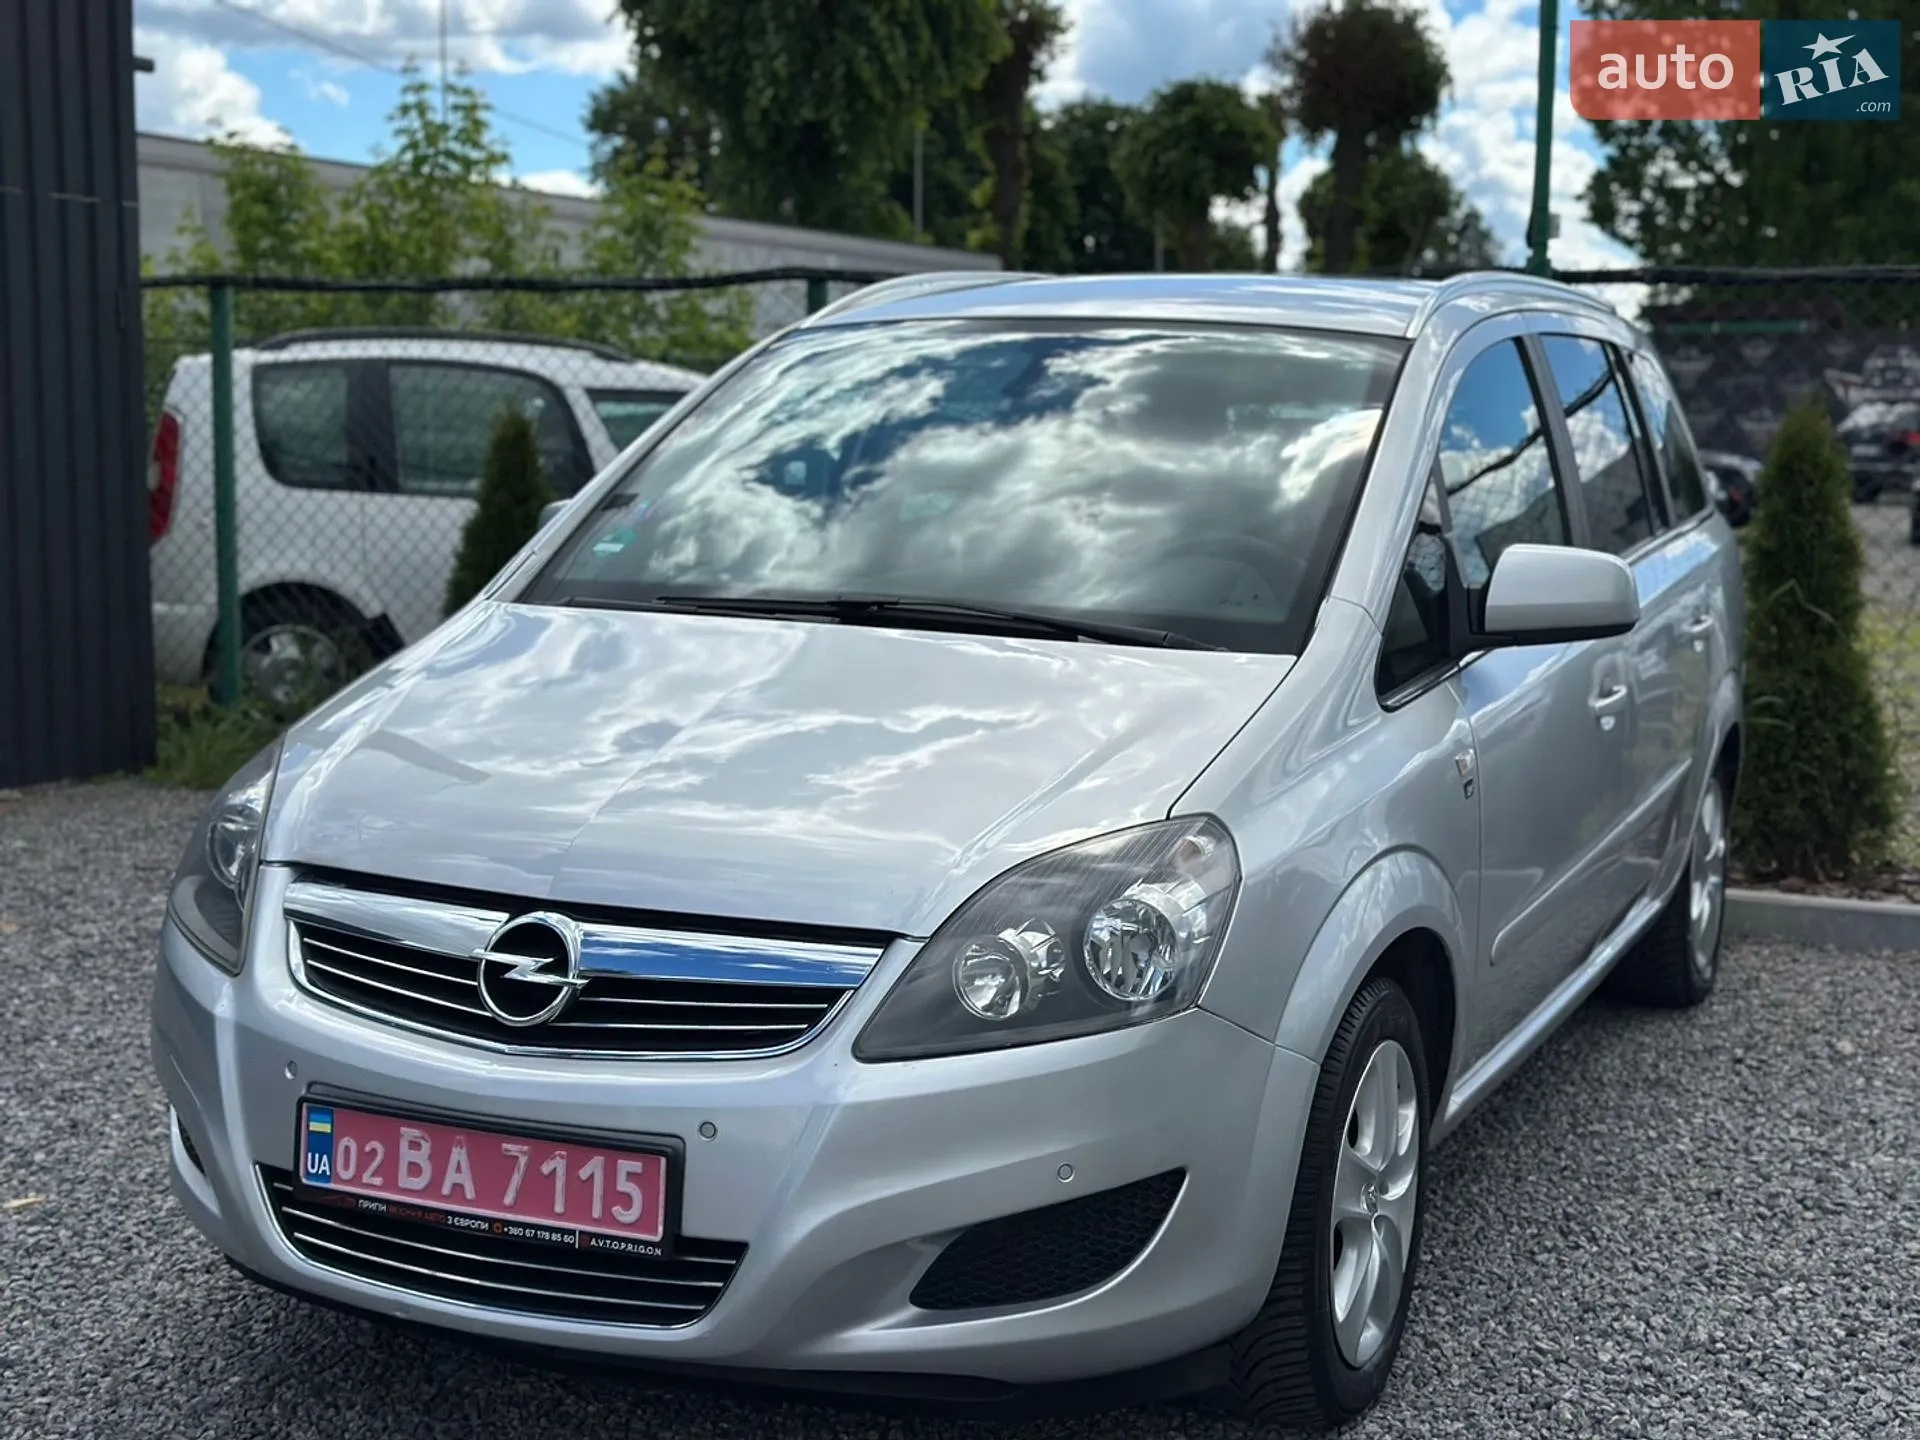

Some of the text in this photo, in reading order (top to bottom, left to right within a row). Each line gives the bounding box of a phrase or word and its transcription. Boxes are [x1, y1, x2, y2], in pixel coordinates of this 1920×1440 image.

[306, 1152, 331, 1176] UA
[336, 1127, 644, 1225] 02 BA 7115
